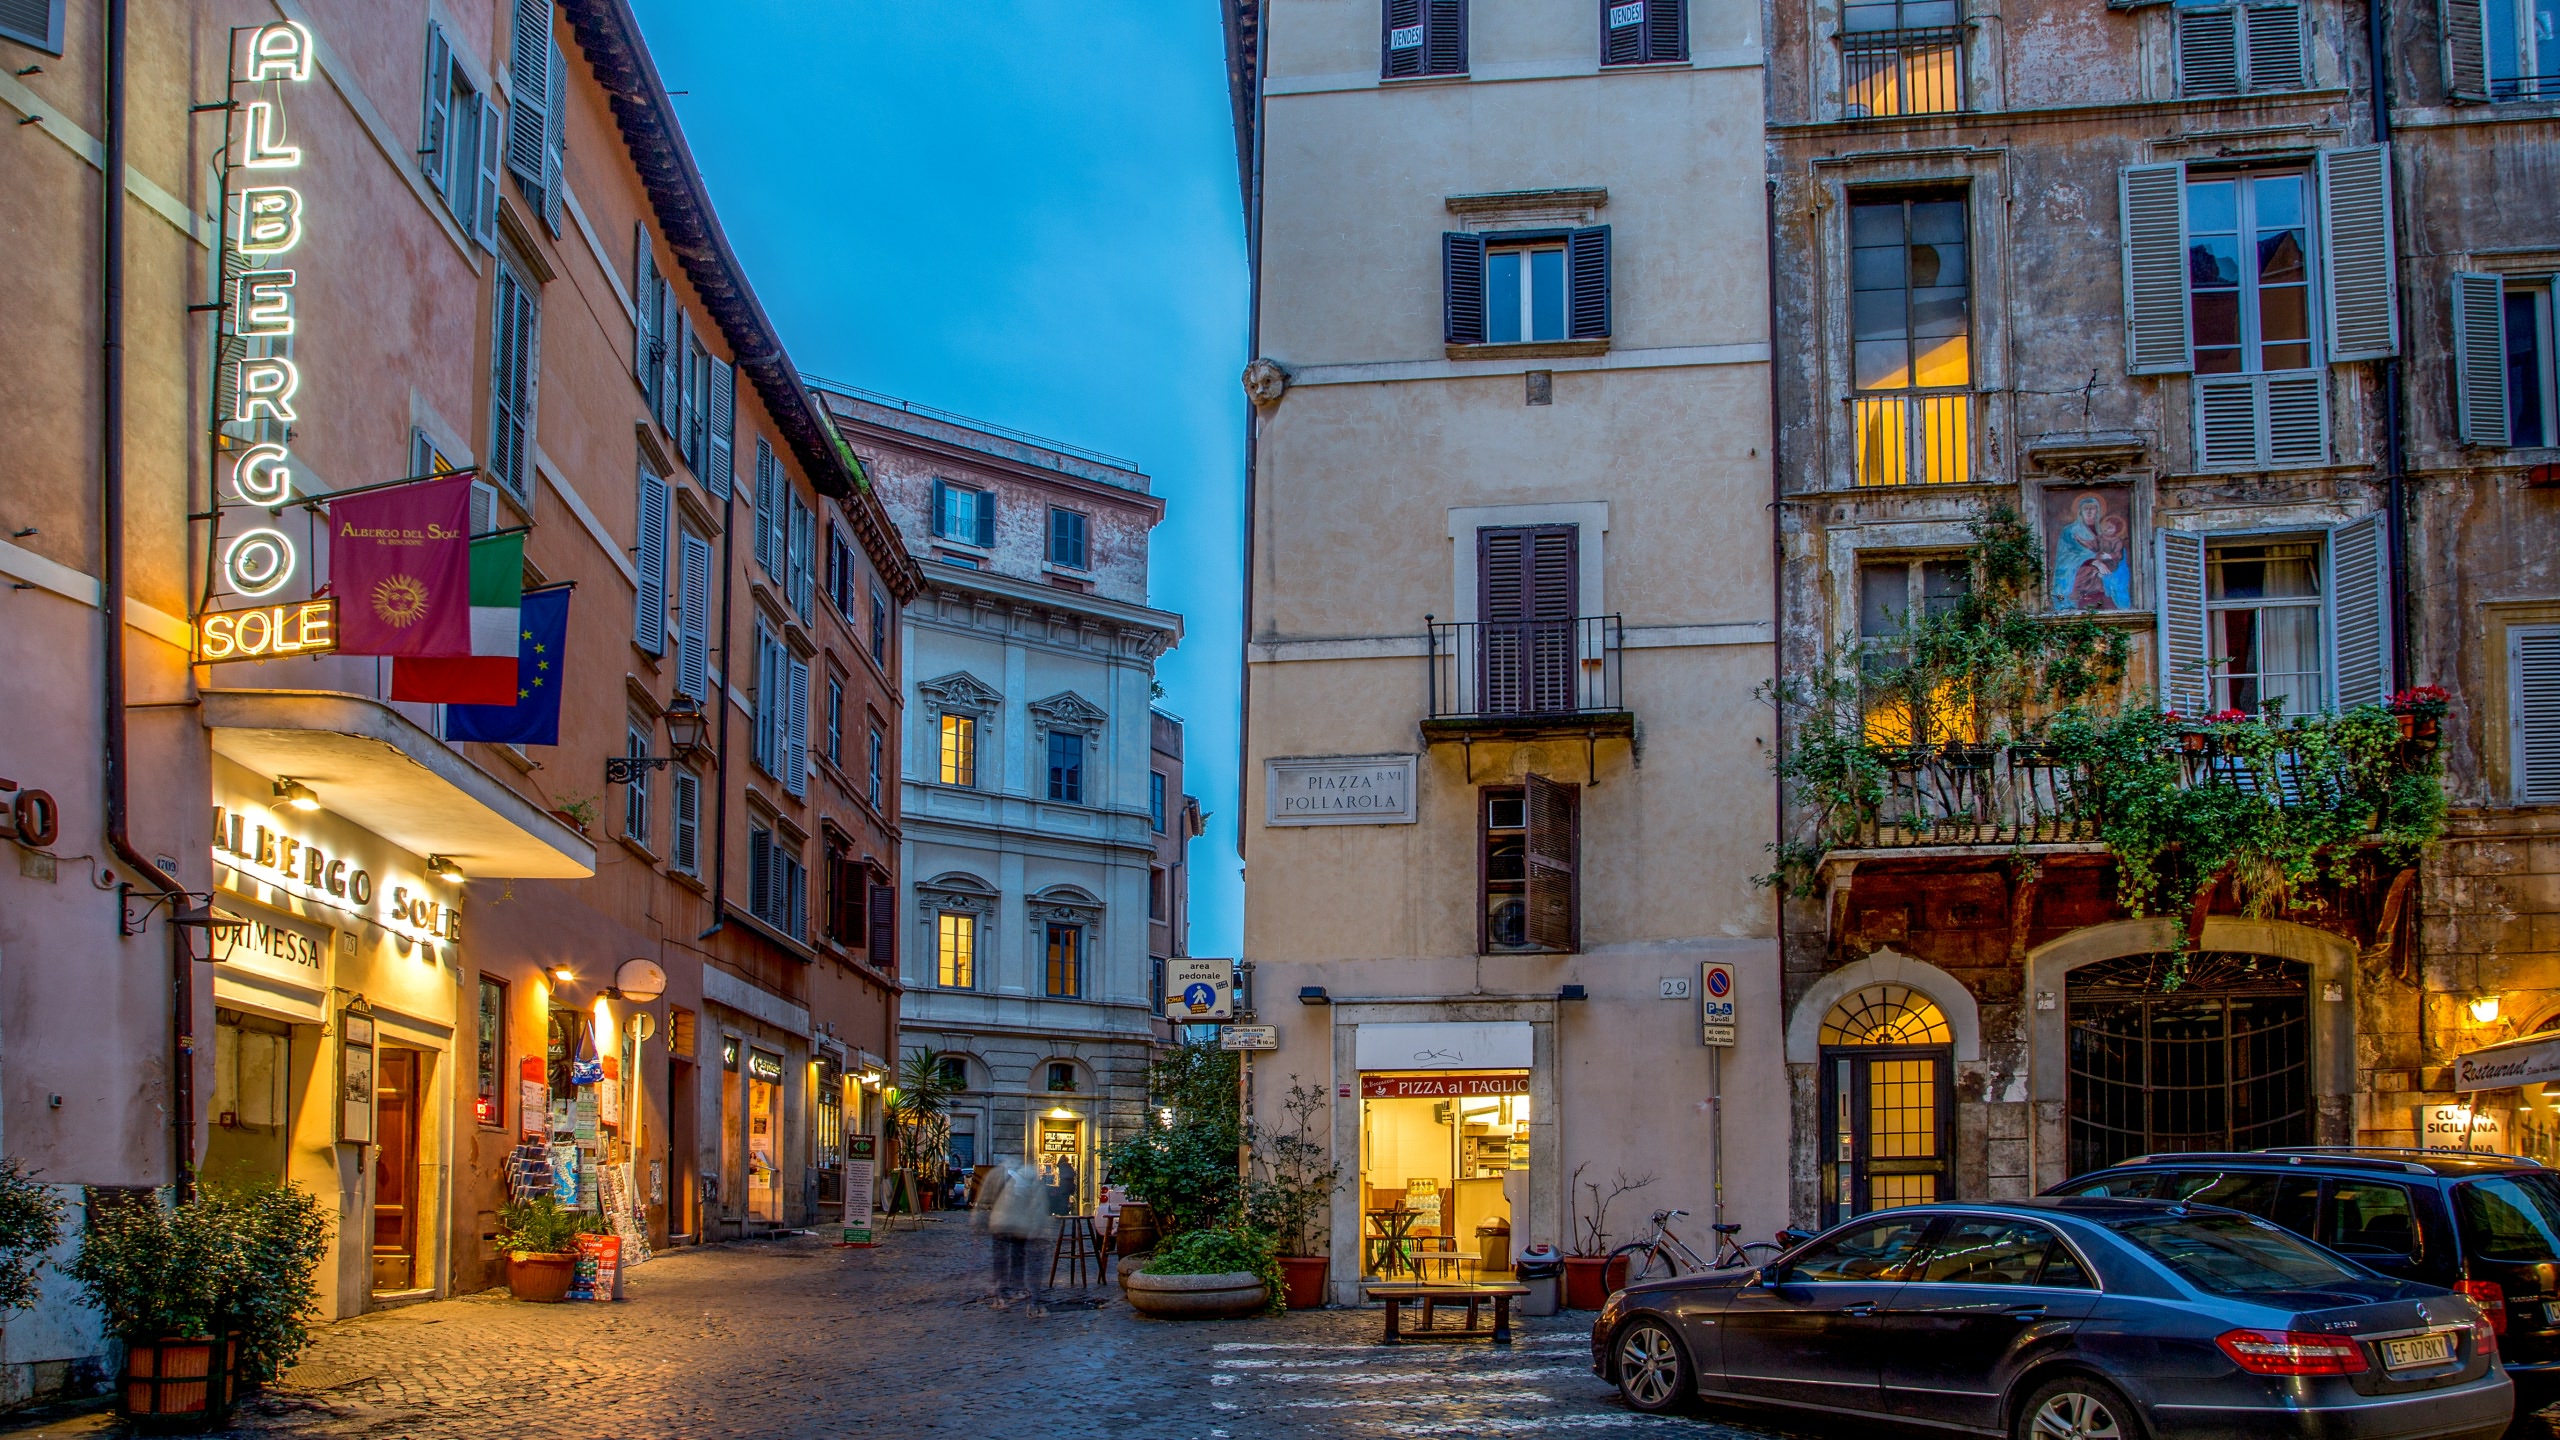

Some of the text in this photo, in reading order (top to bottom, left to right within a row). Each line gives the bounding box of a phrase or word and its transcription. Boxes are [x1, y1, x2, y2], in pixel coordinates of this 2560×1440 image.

[1612, 4, 1641, 25] VENDESI
[1392, 27, 1421, 47] VENDESI
[224, 20, 312, 597] ALBERGO
[202, 603, 331, 657] SOLE
[1308, 775, 1372, 791] PIAZZA
[1285, 795, 1396, 810] POLLAROLA
[157, 858, 177, 872] 1709
[213, 806, 460, 944] ALBERGO SOLE
[345, 935, 356, 953] 75
[1179, 972, 1221, 980] pedonale
[1662, 981, 1687, 995] 29
[574, 1066, 601, 1078] Roma
[2460, 1056, 2529, 1084] Restaurant
[1398, 1079, 1529, 1095] PIZZA al TAGLIO
[2332, 1320, 2358, 1329] 250
[2391, 1338, 2448, 1363] EF 078KY
